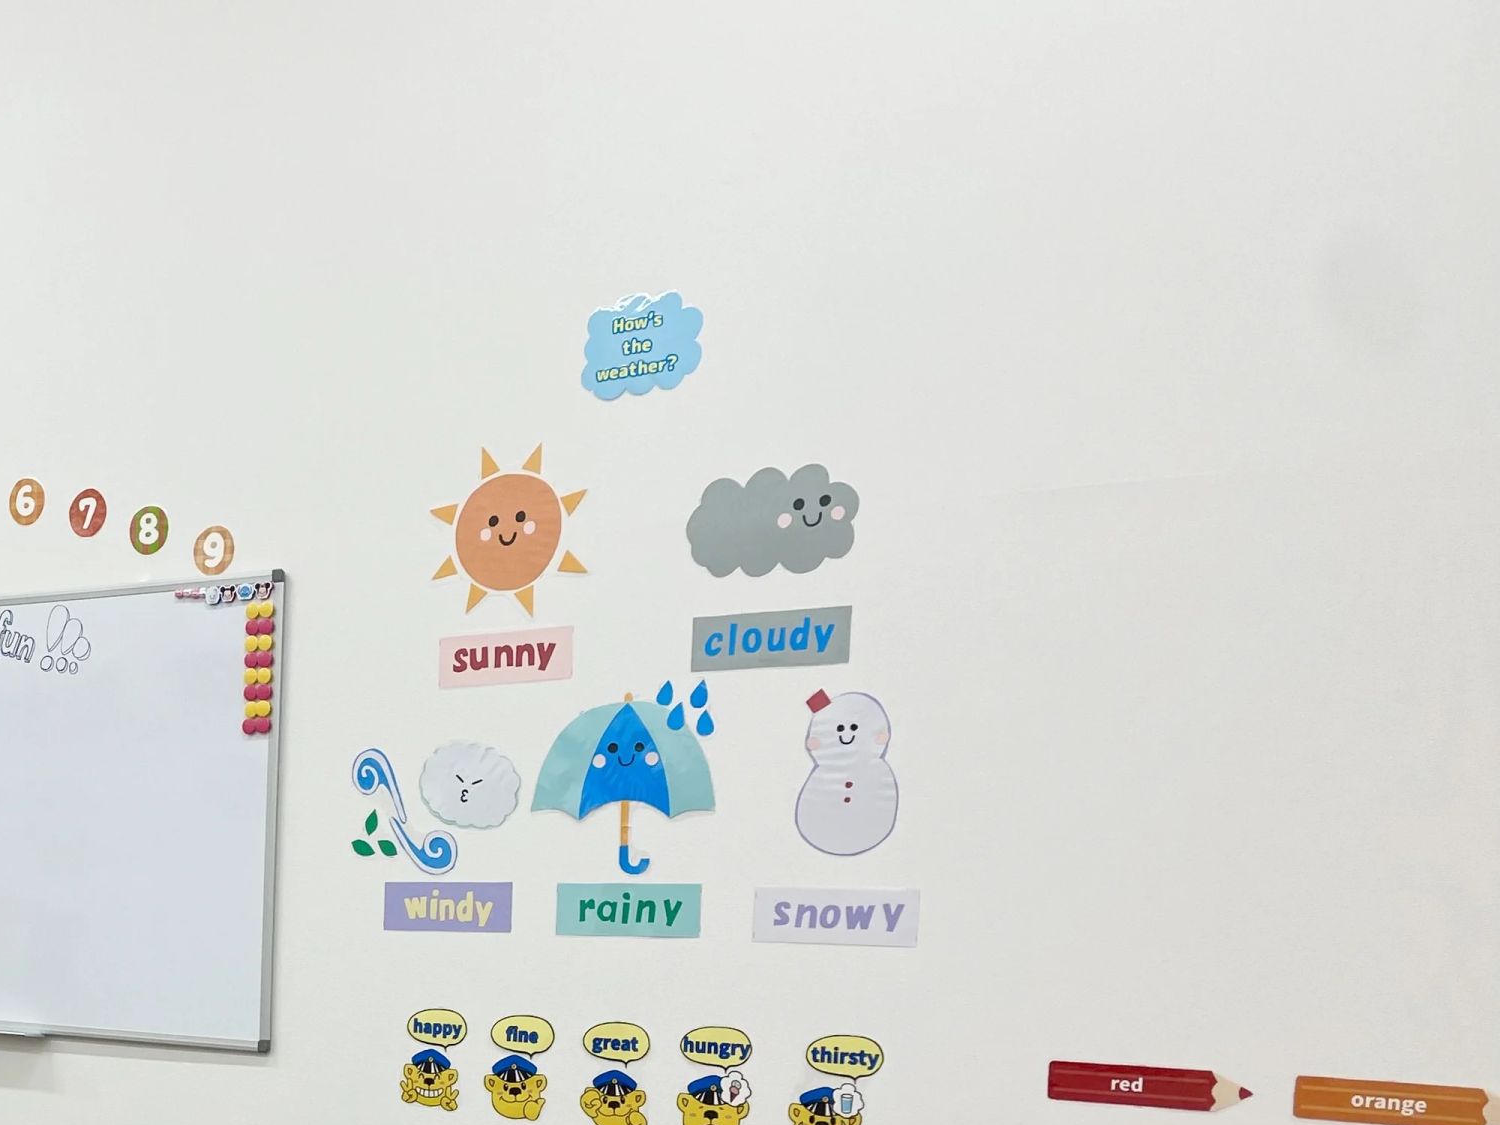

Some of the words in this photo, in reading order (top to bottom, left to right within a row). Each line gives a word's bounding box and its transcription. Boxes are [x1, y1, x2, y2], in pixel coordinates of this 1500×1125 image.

[612, 311, 663, 334] How's
[622, 337, 652, 356] the
[596, 354, 679, 383] weather?
[15, 484, 36, 517] 6
[78, 497, 97, 530] 7
[138, 512, 159, 545] 8
[202, 531, 225, 568] 9
[703, 618, 836, 658] cloudy
[452, 642, 556, 674] sunny
[403, 891, 494, 927] windy
[579, 893, 683, 926] rainy
[772, 899, 906, 933] snowy
[412, 1019, 462, 1039] happy
[505, 1026, 539, 1044] fine
[591, 1036, 638, 1054] great
[683, 1036, 750, 1060] hungry
[811, 1047, 879, 1070] thirsty
[1110, 1076, 1144, 1094] red
[1350, 1093, 1427, 1116] orange
